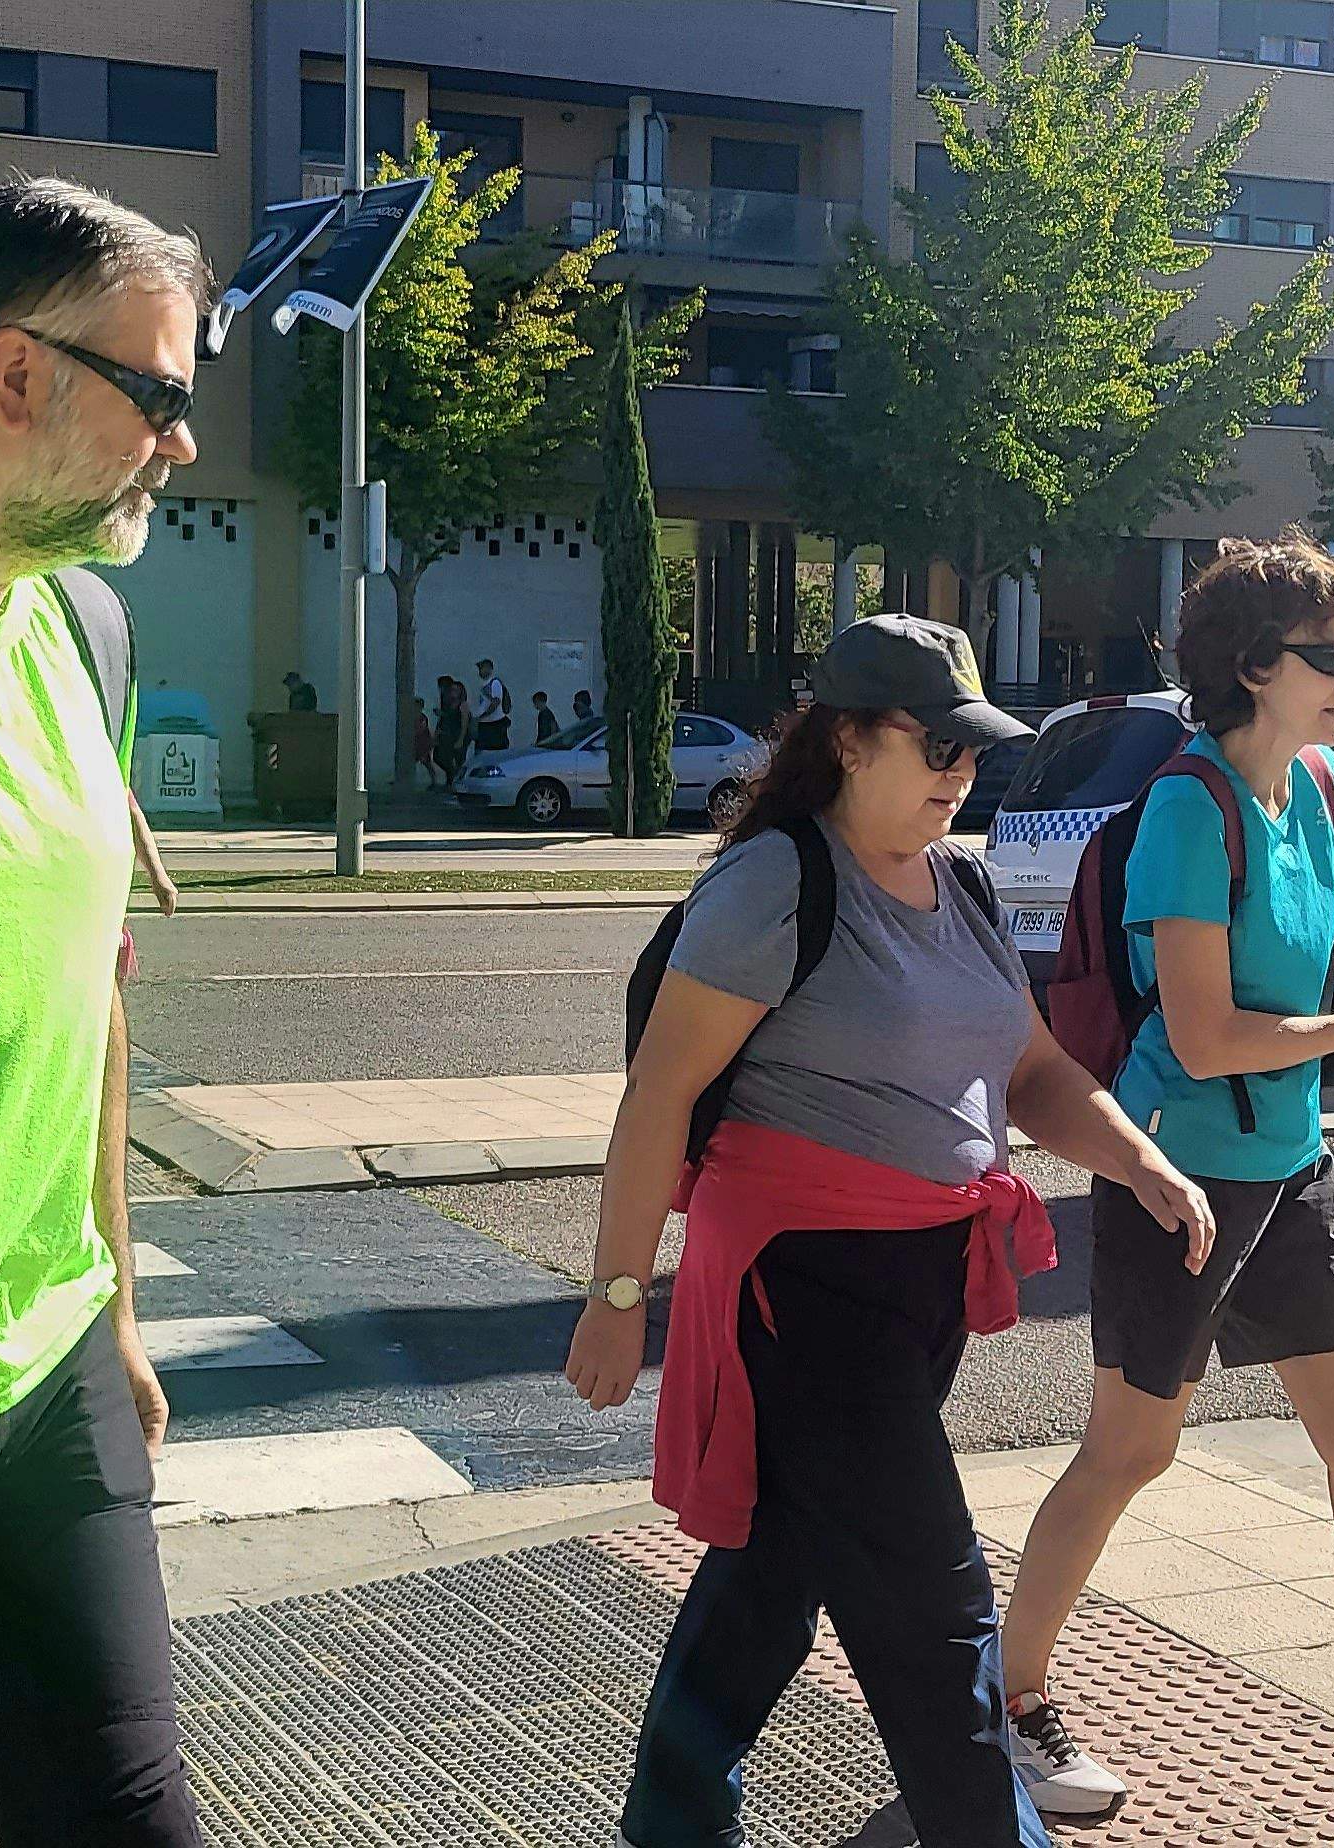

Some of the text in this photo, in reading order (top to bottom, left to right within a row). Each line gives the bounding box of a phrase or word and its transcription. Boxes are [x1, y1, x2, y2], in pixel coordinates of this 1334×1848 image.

[1013, 873, 1052, 883] SCENIC
[1017, 911, 1065, 932] 7999 HB
